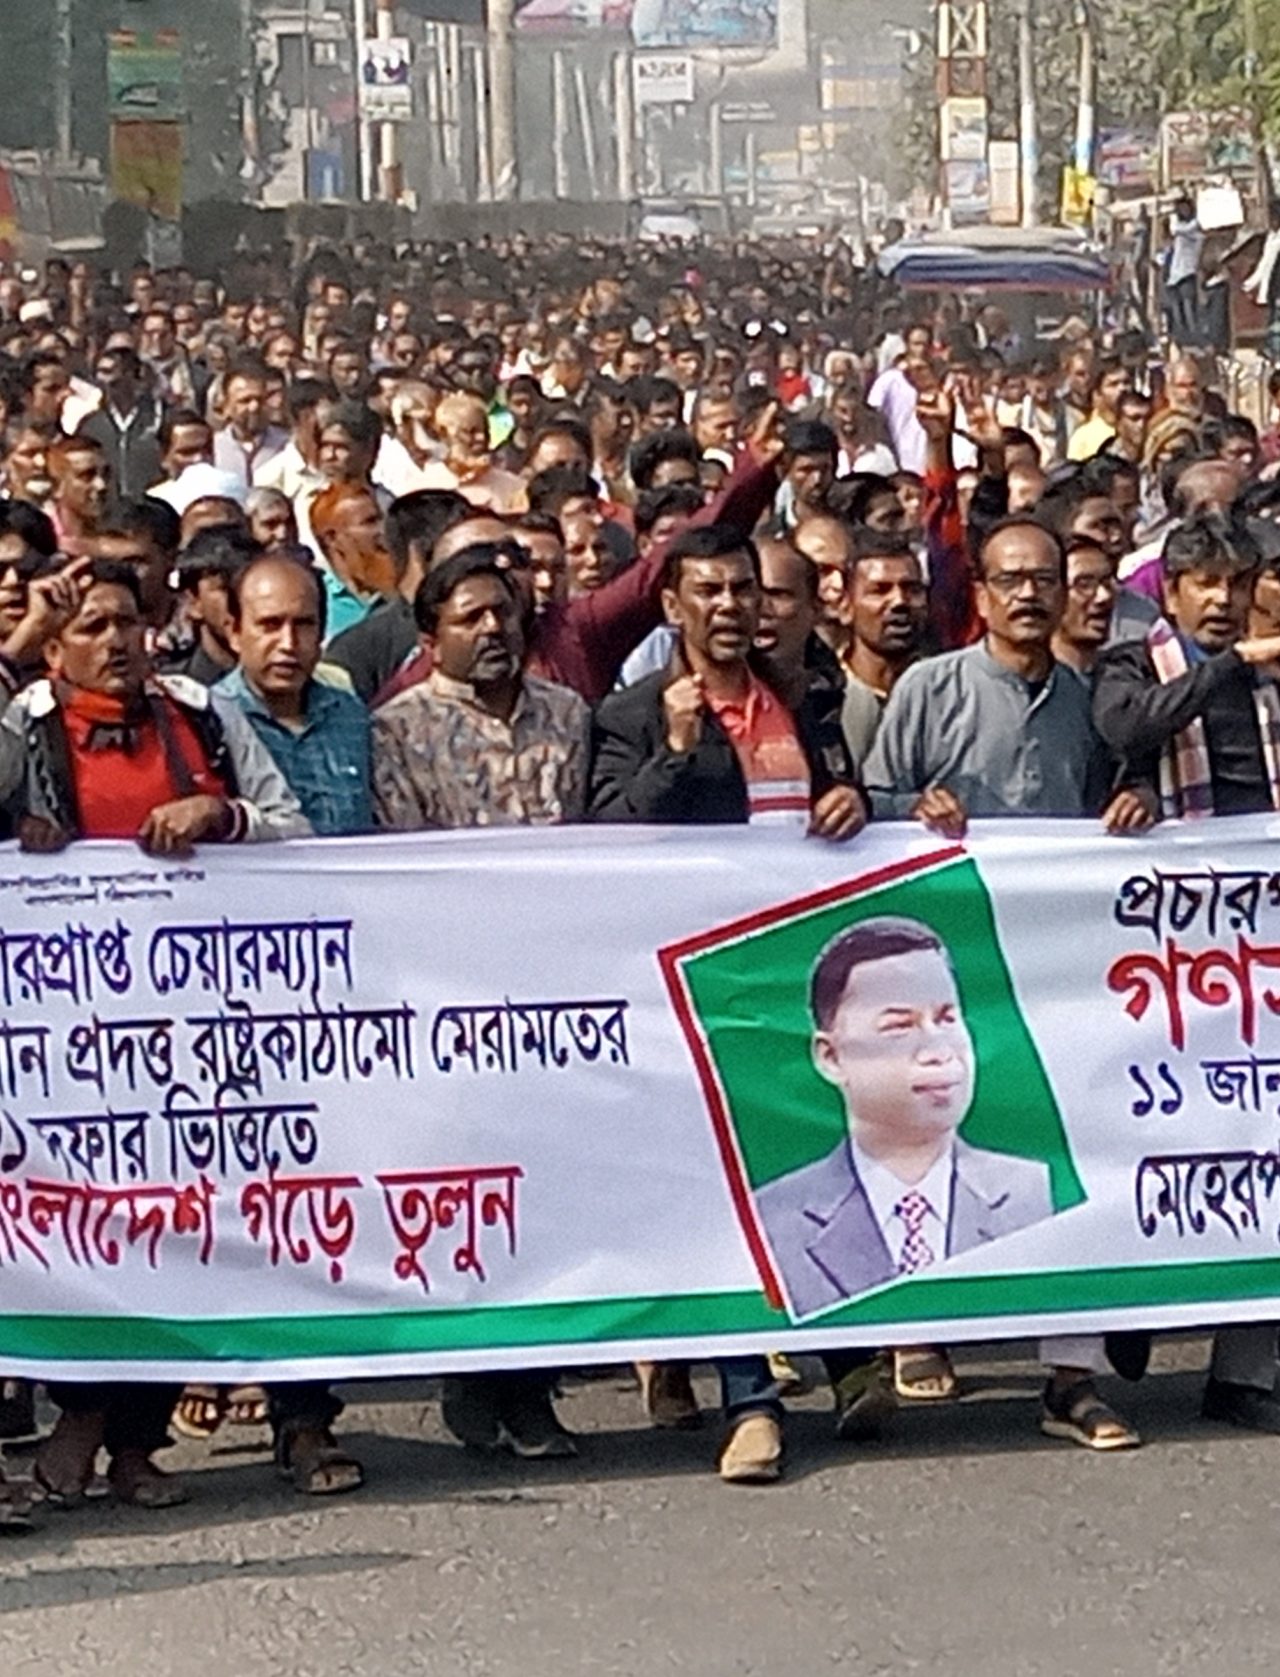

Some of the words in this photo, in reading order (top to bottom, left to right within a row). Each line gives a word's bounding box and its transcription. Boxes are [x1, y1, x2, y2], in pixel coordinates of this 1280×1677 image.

[0, 917, 131, 1003] ারপ্রাপ্ত
[148, 918, 353, 995] চেয়ারম্যান
[66, 1012, 174, 1097] প্রদত্ত
[186, 990, 416, 1097] রাষ্ট্রকাঠামো
[431, 997, 630, 1074] মেরামতের
[1128, 1063, 1182, 1117] ১১
[0, 1108, 27, 1173] ১
[160, 1082, 319, 1182] ভিত্তিতে
[0, 1172, 216, 1270] াংলাদেশ
[240, 1168, 361, 1284] গড়ে
[376, 1165, 523, 1294] তুলুন
